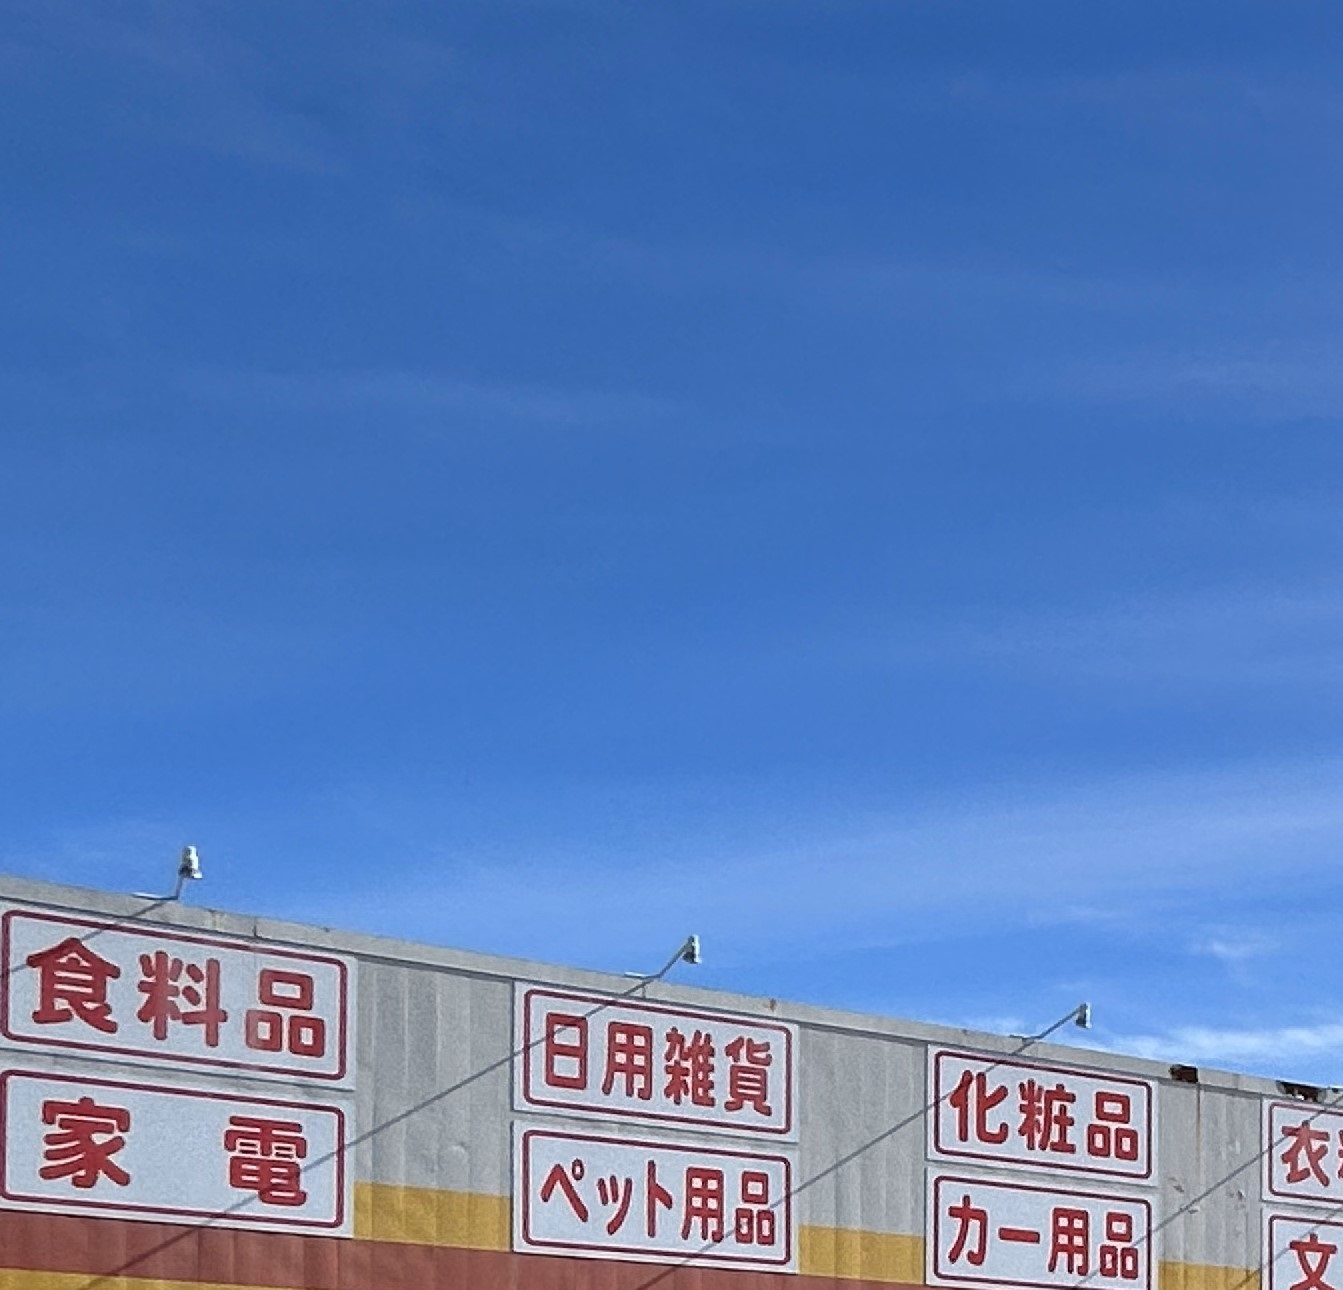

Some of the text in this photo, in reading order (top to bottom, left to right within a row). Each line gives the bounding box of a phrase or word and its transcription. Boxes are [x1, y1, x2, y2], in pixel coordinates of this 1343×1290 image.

[27, 937, 325, 1058] 食料品
[544, 1012, 773, 1118] 日用雑貨
[949, 1070, 1139, 1161] 化粧品
[541, 1157, 776, 1246] ペット用品
[947, 1195, 1139, 1280] カー用品
